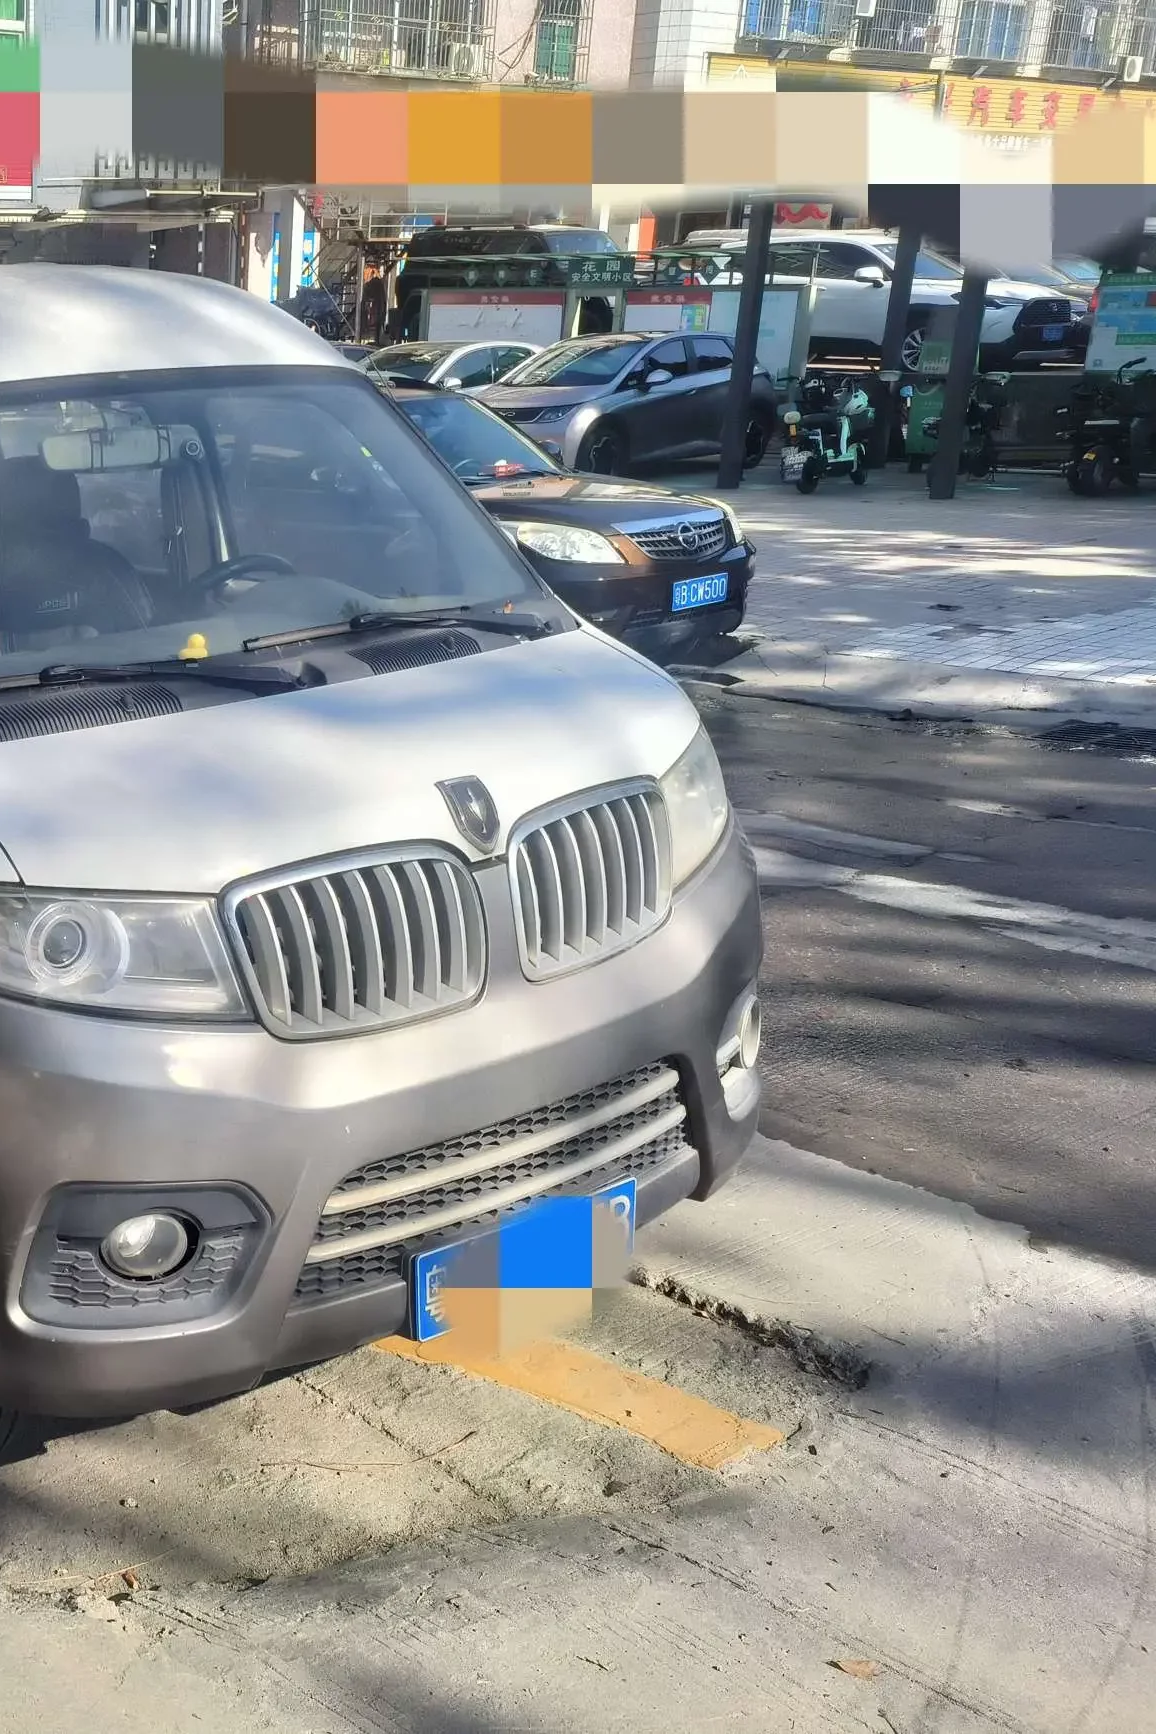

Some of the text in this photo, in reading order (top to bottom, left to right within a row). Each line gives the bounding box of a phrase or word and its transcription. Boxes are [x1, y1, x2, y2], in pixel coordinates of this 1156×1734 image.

[571, 272, 632, 282] 安全文明小区
